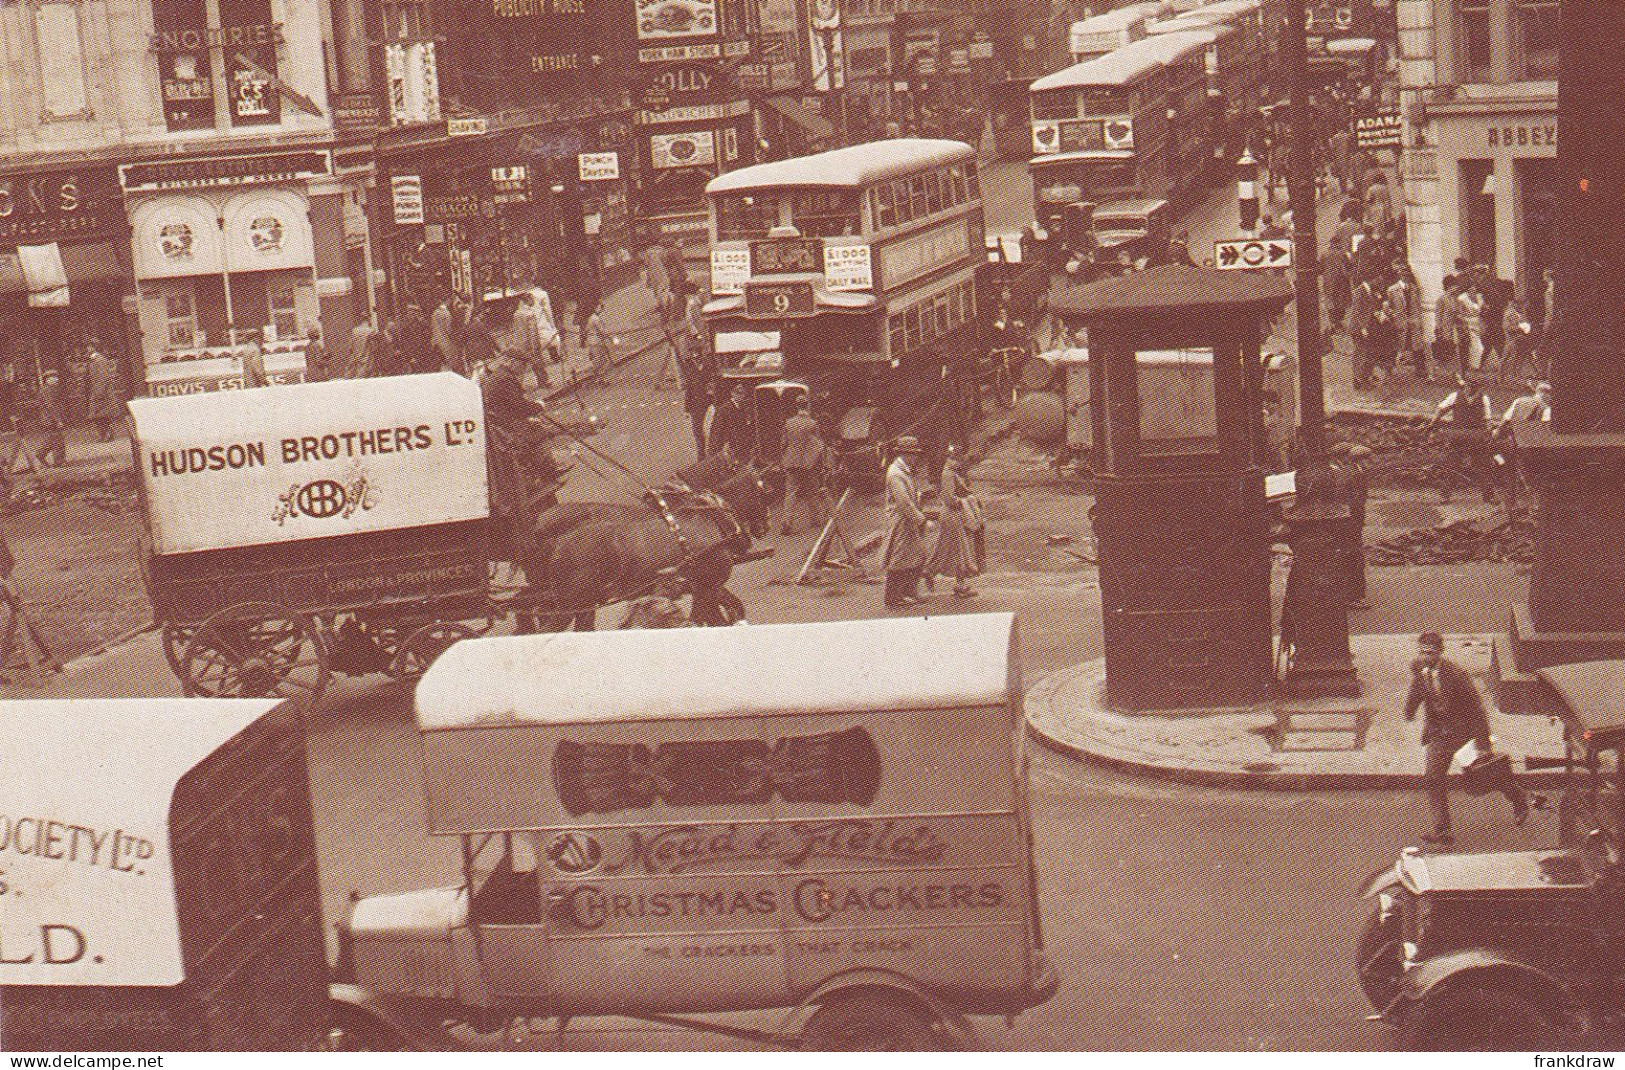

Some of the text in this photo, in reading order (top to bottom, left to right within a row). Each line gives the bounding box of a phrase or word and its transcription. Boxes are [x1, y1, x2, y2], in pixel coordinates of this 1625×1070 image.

[1488, 126, 1556, 147] ABBEY
[583, 156, 614, 166] PUNCH
[582, 168, 616, 178] TAVERN
[714, 252, 747, 264] £1000
[827, 247, 868, 260] £1000
[827, 277, 848, 288] DAILY
[773, 293, 790, 313] 9
[151, 441, 266, 477] HUDSON
[280, 424, 432, 464] BROTHERS
[396, 563, 476, 585] PROVINCES
[568, 877, 1004, 931] CHRISTMAS CRACKERS
[679, 942, 776, 960] CRACKERS
[795, 940, 845, 955] THAT
